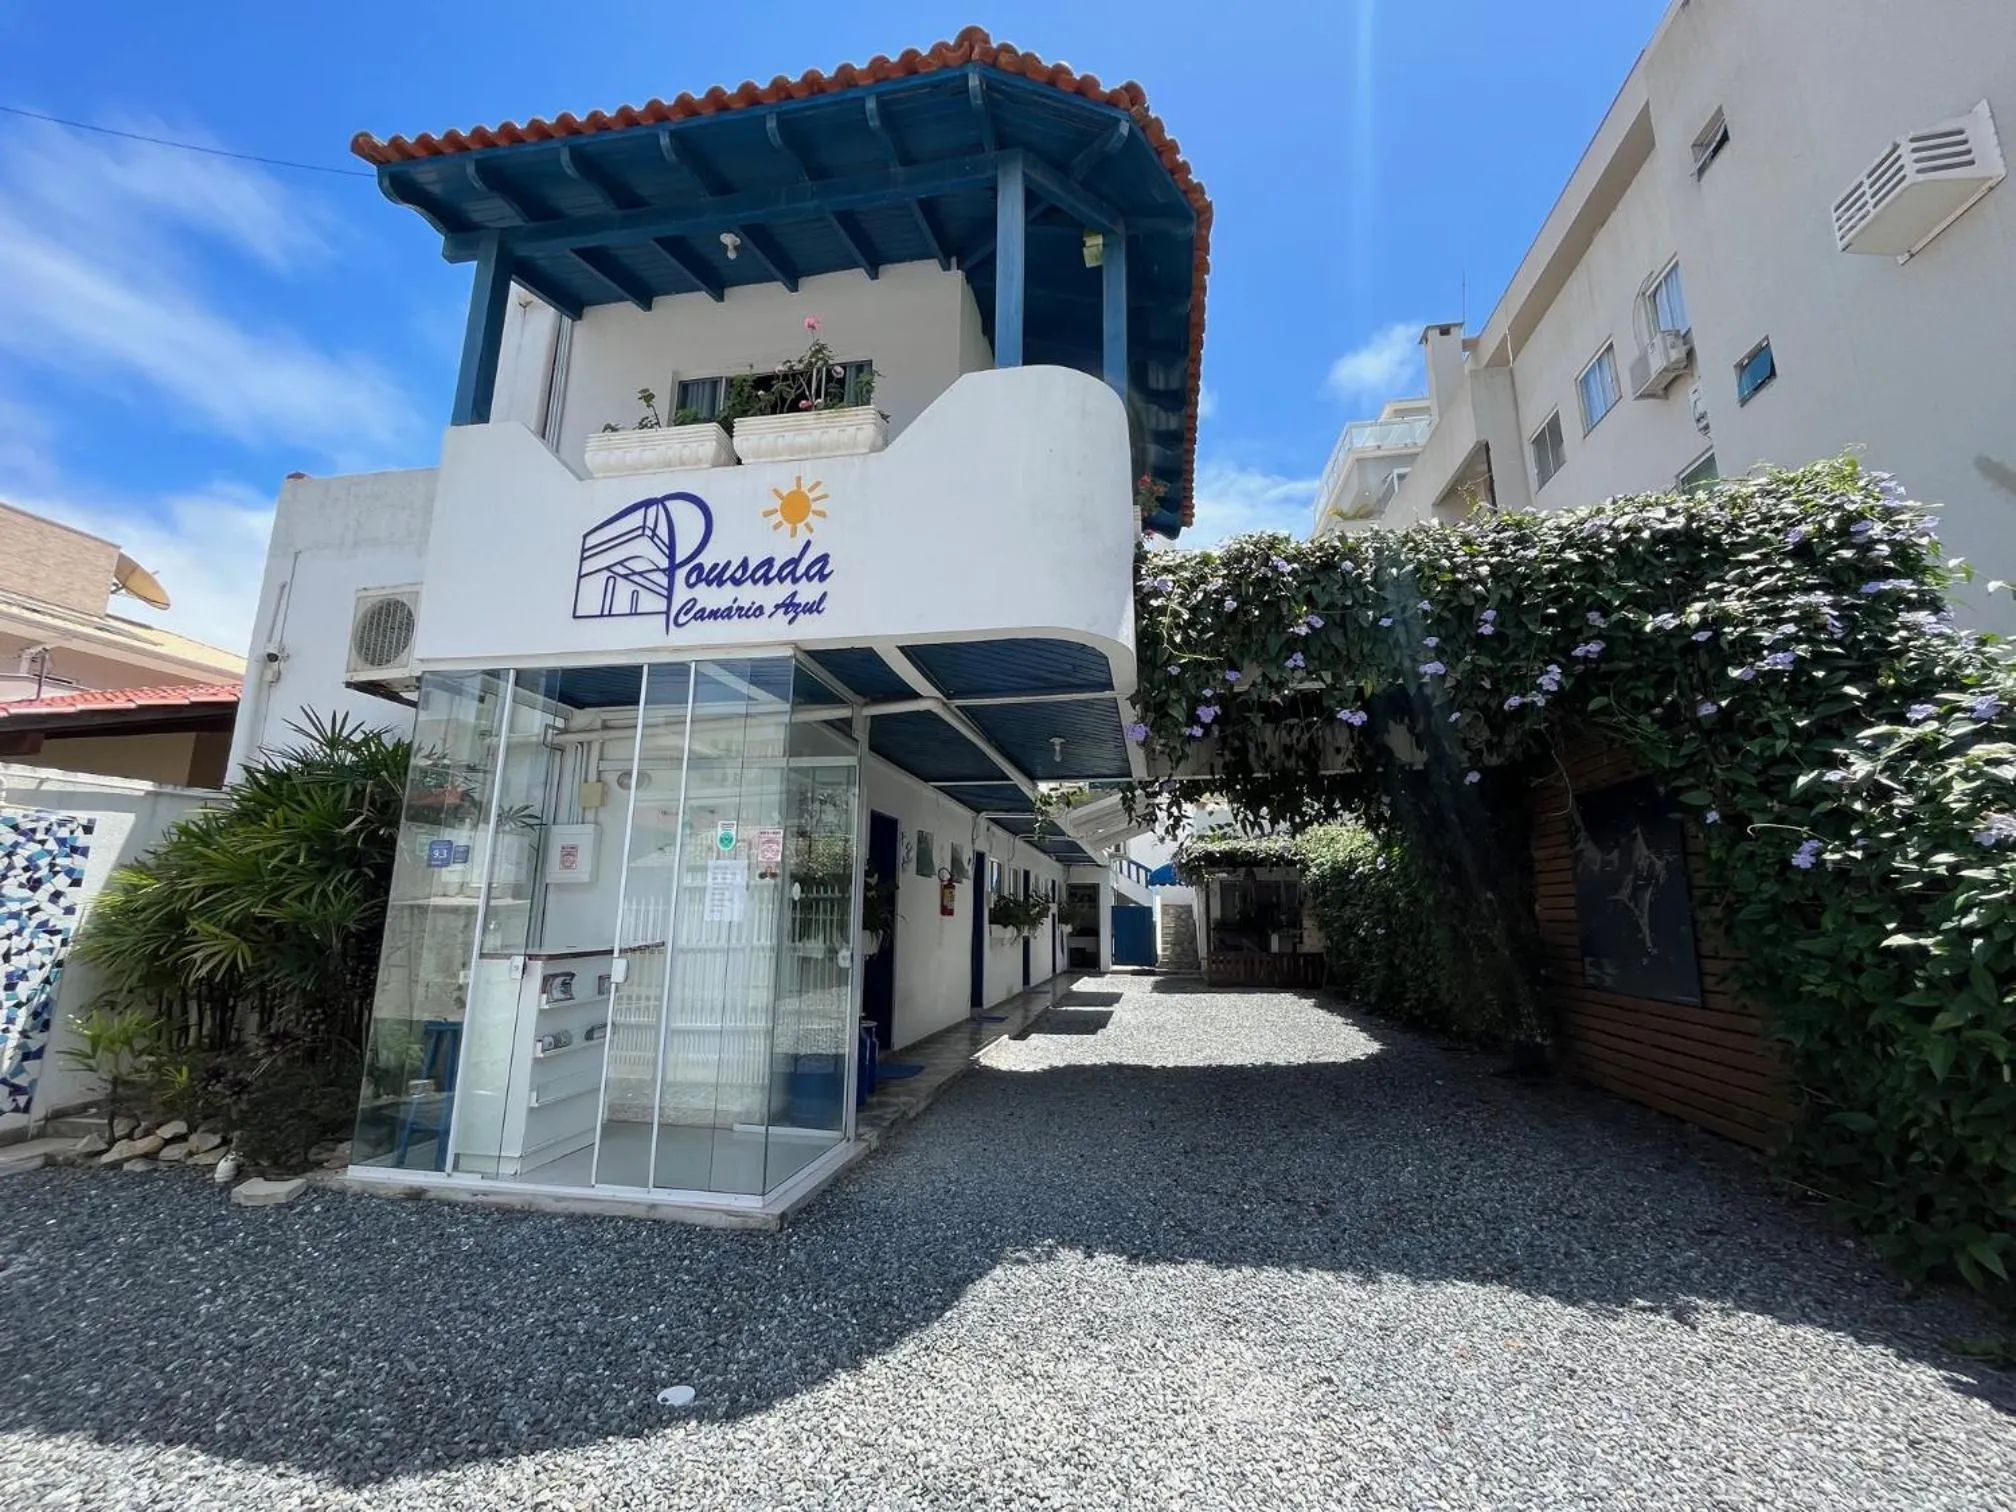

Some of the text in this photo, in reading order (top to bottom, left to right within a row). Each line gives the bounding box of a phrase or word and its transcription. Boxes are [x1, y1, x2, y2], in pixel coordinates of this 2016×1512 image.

[659, 492, 833, 635] Pousada
[673, 591, 826, 628] Canário Azul
